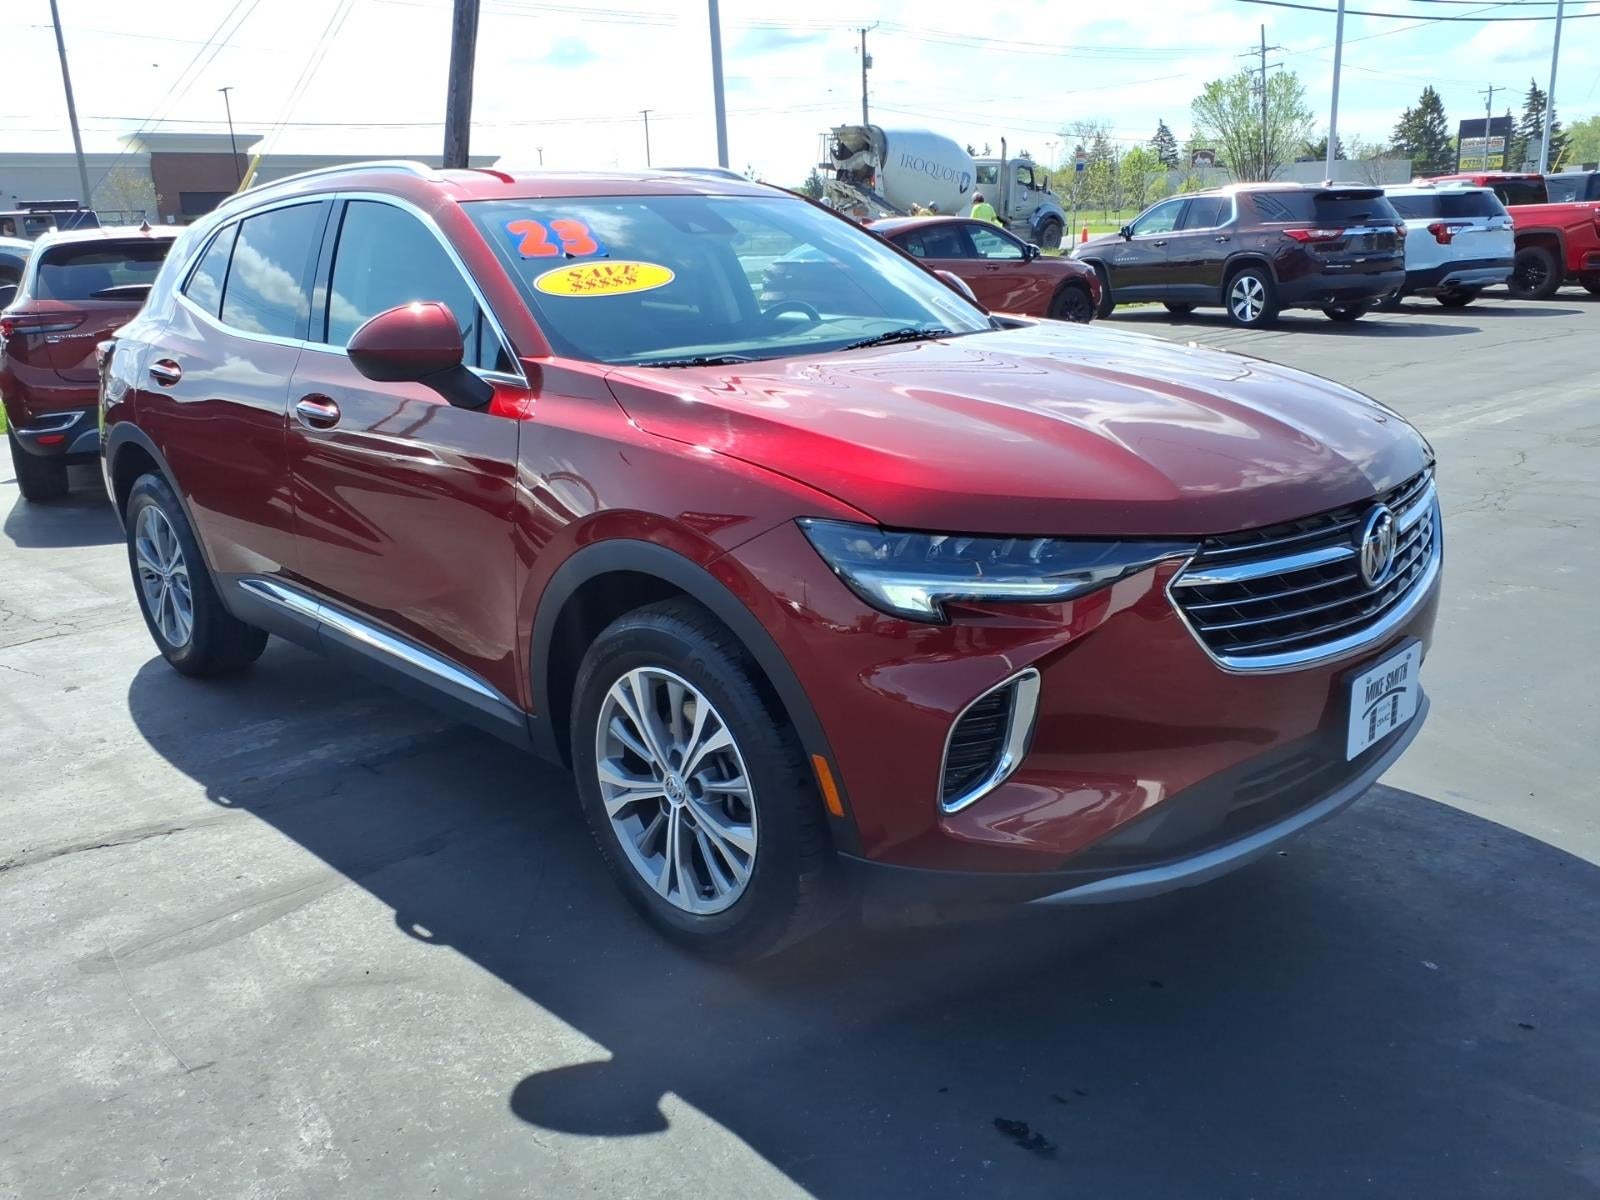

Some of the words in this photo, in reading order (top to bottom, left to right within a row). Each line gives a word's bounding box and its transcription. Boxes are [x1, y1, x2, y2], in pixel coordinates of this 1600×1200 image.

[900, 153, 960, 183] IROQUOIS
[506, 219, 598, 257] 23
[567, 264, 640, 281] SAVE
[1364, 676, 1385, 704] MIKE
[1385, 661, 1409, 692] SMITH
